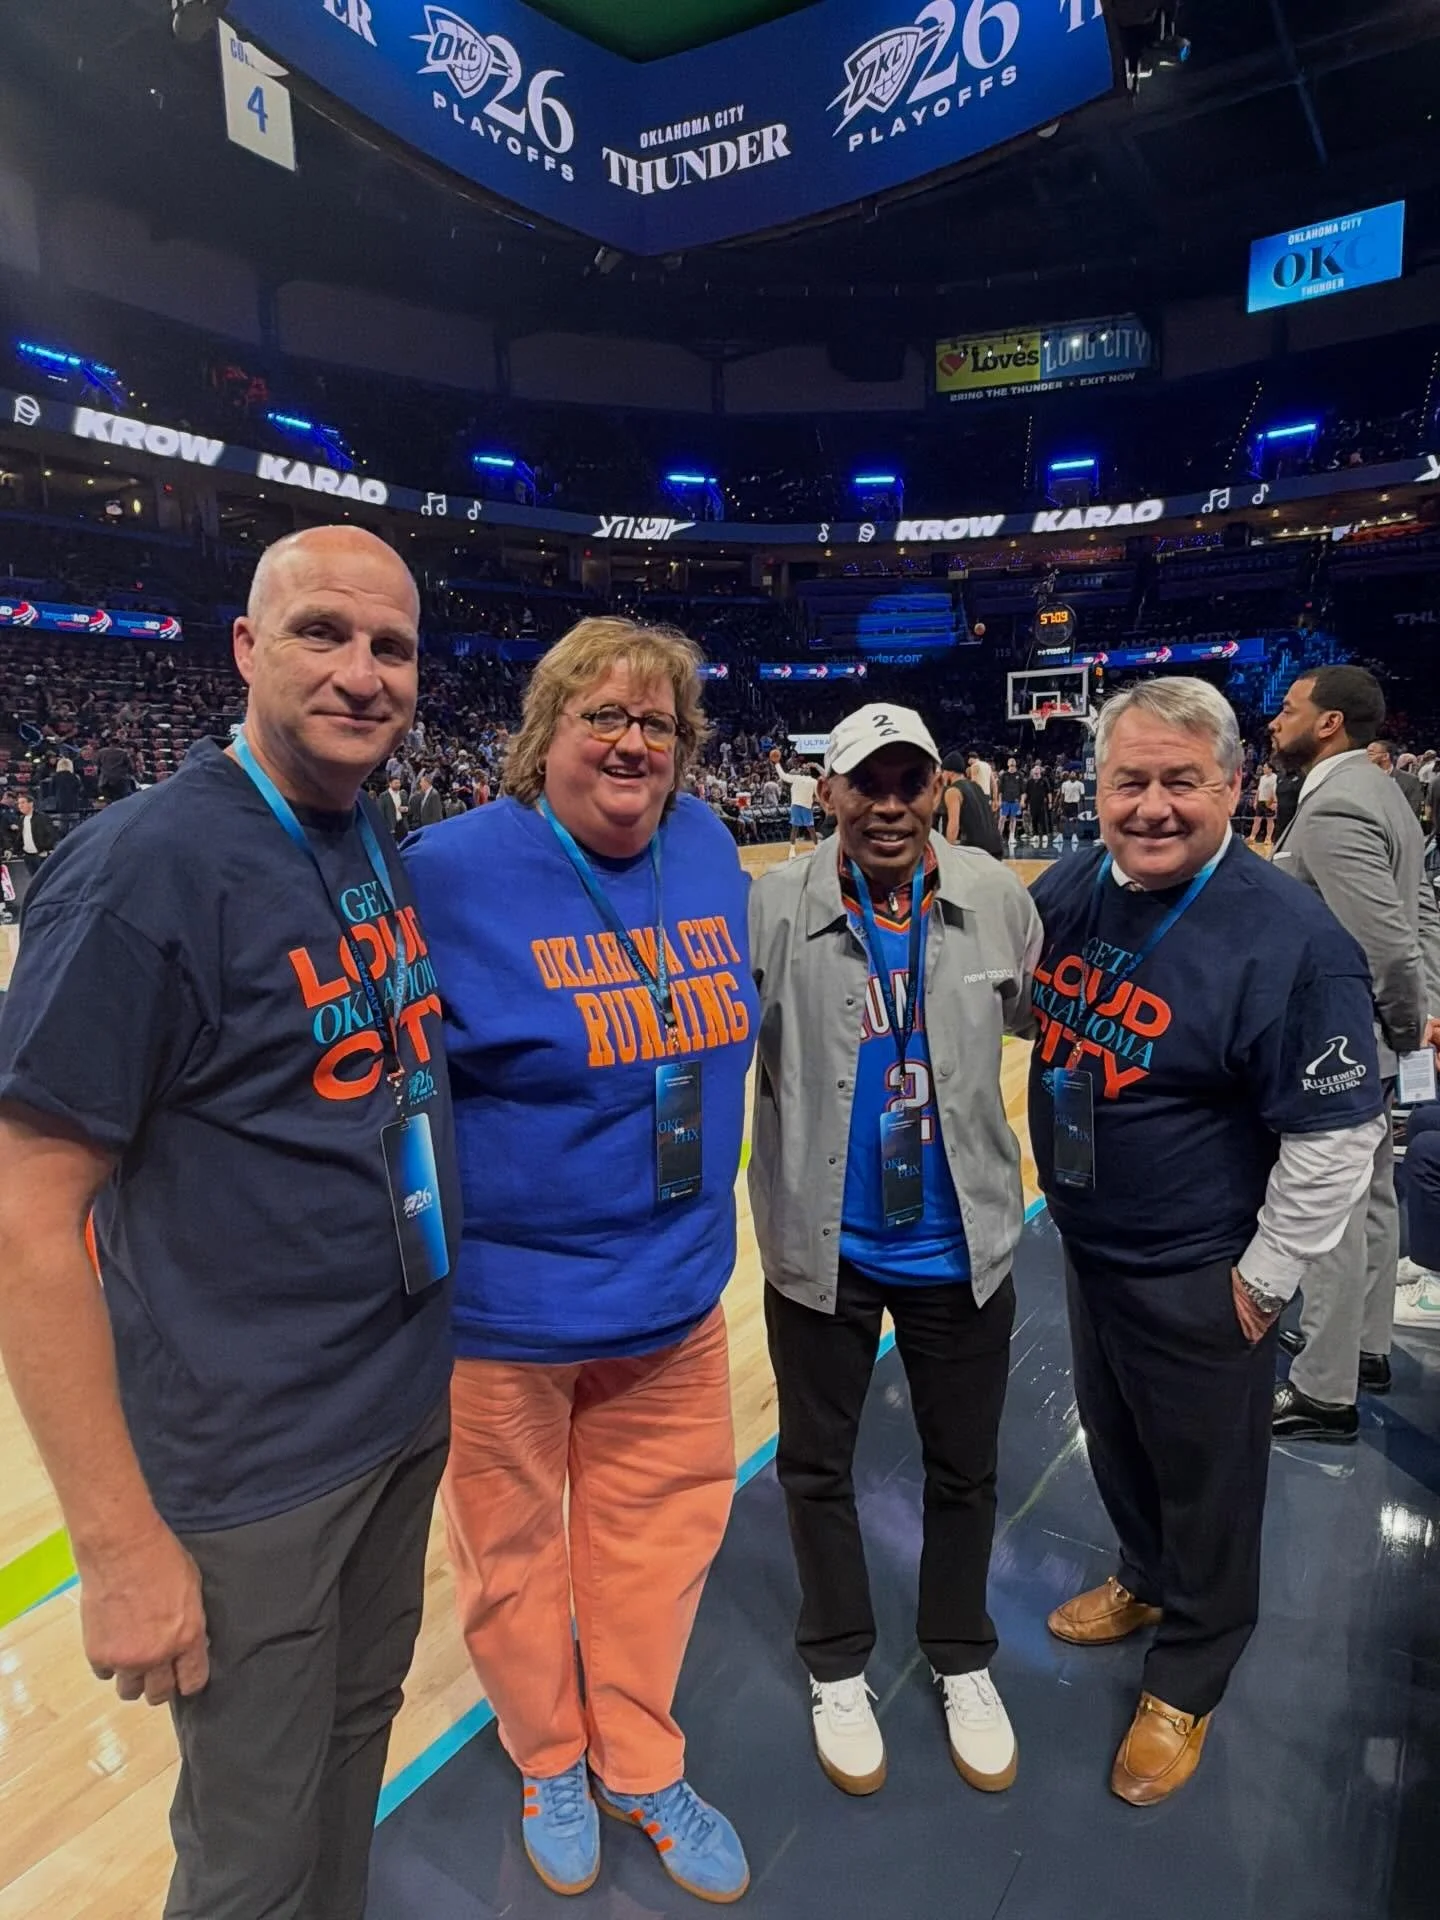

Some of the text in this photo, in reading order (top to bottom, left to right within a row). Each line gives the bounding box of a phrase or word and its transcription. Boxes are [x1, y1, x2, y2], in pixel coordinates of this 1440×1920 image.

[431, 32, 478, 61] OKC
[906, 0, 1020, 104] 26
[483, 34, 575, 154] 26
[850, 40, 905, 103] OKC
[247, 85, 269, 134] 4
[639, 103, 745, 149] OKLAHOMA CITY
[848, 65, 1017, 153] PLAYOFFS
[432, 91, 575, 182] PLAYOFFS
[602, 123, 792, 195] THUNDER
[1287, 216, 1363, 246] OKLAHOMA CITY
[1301, 277, 1345, 297] THUNDER
[1103, 328, 1146, 361] CITY
[950, 371, 1136, 402] BRING THE THUNDER EXIT NOW
[73, 406, 388, 505] KROW KARAO
[895, 499, 1164, 541] KROW KARAO
[677, 915, 741, 969] CITY
[1082, 936, 1134, 975] GET
[574, 971, 750, 1067] RUNNING
[1302, 1064, 1367, 1091] RIVERWIND
[1319, 1079, 1361, 1096] CASINO
